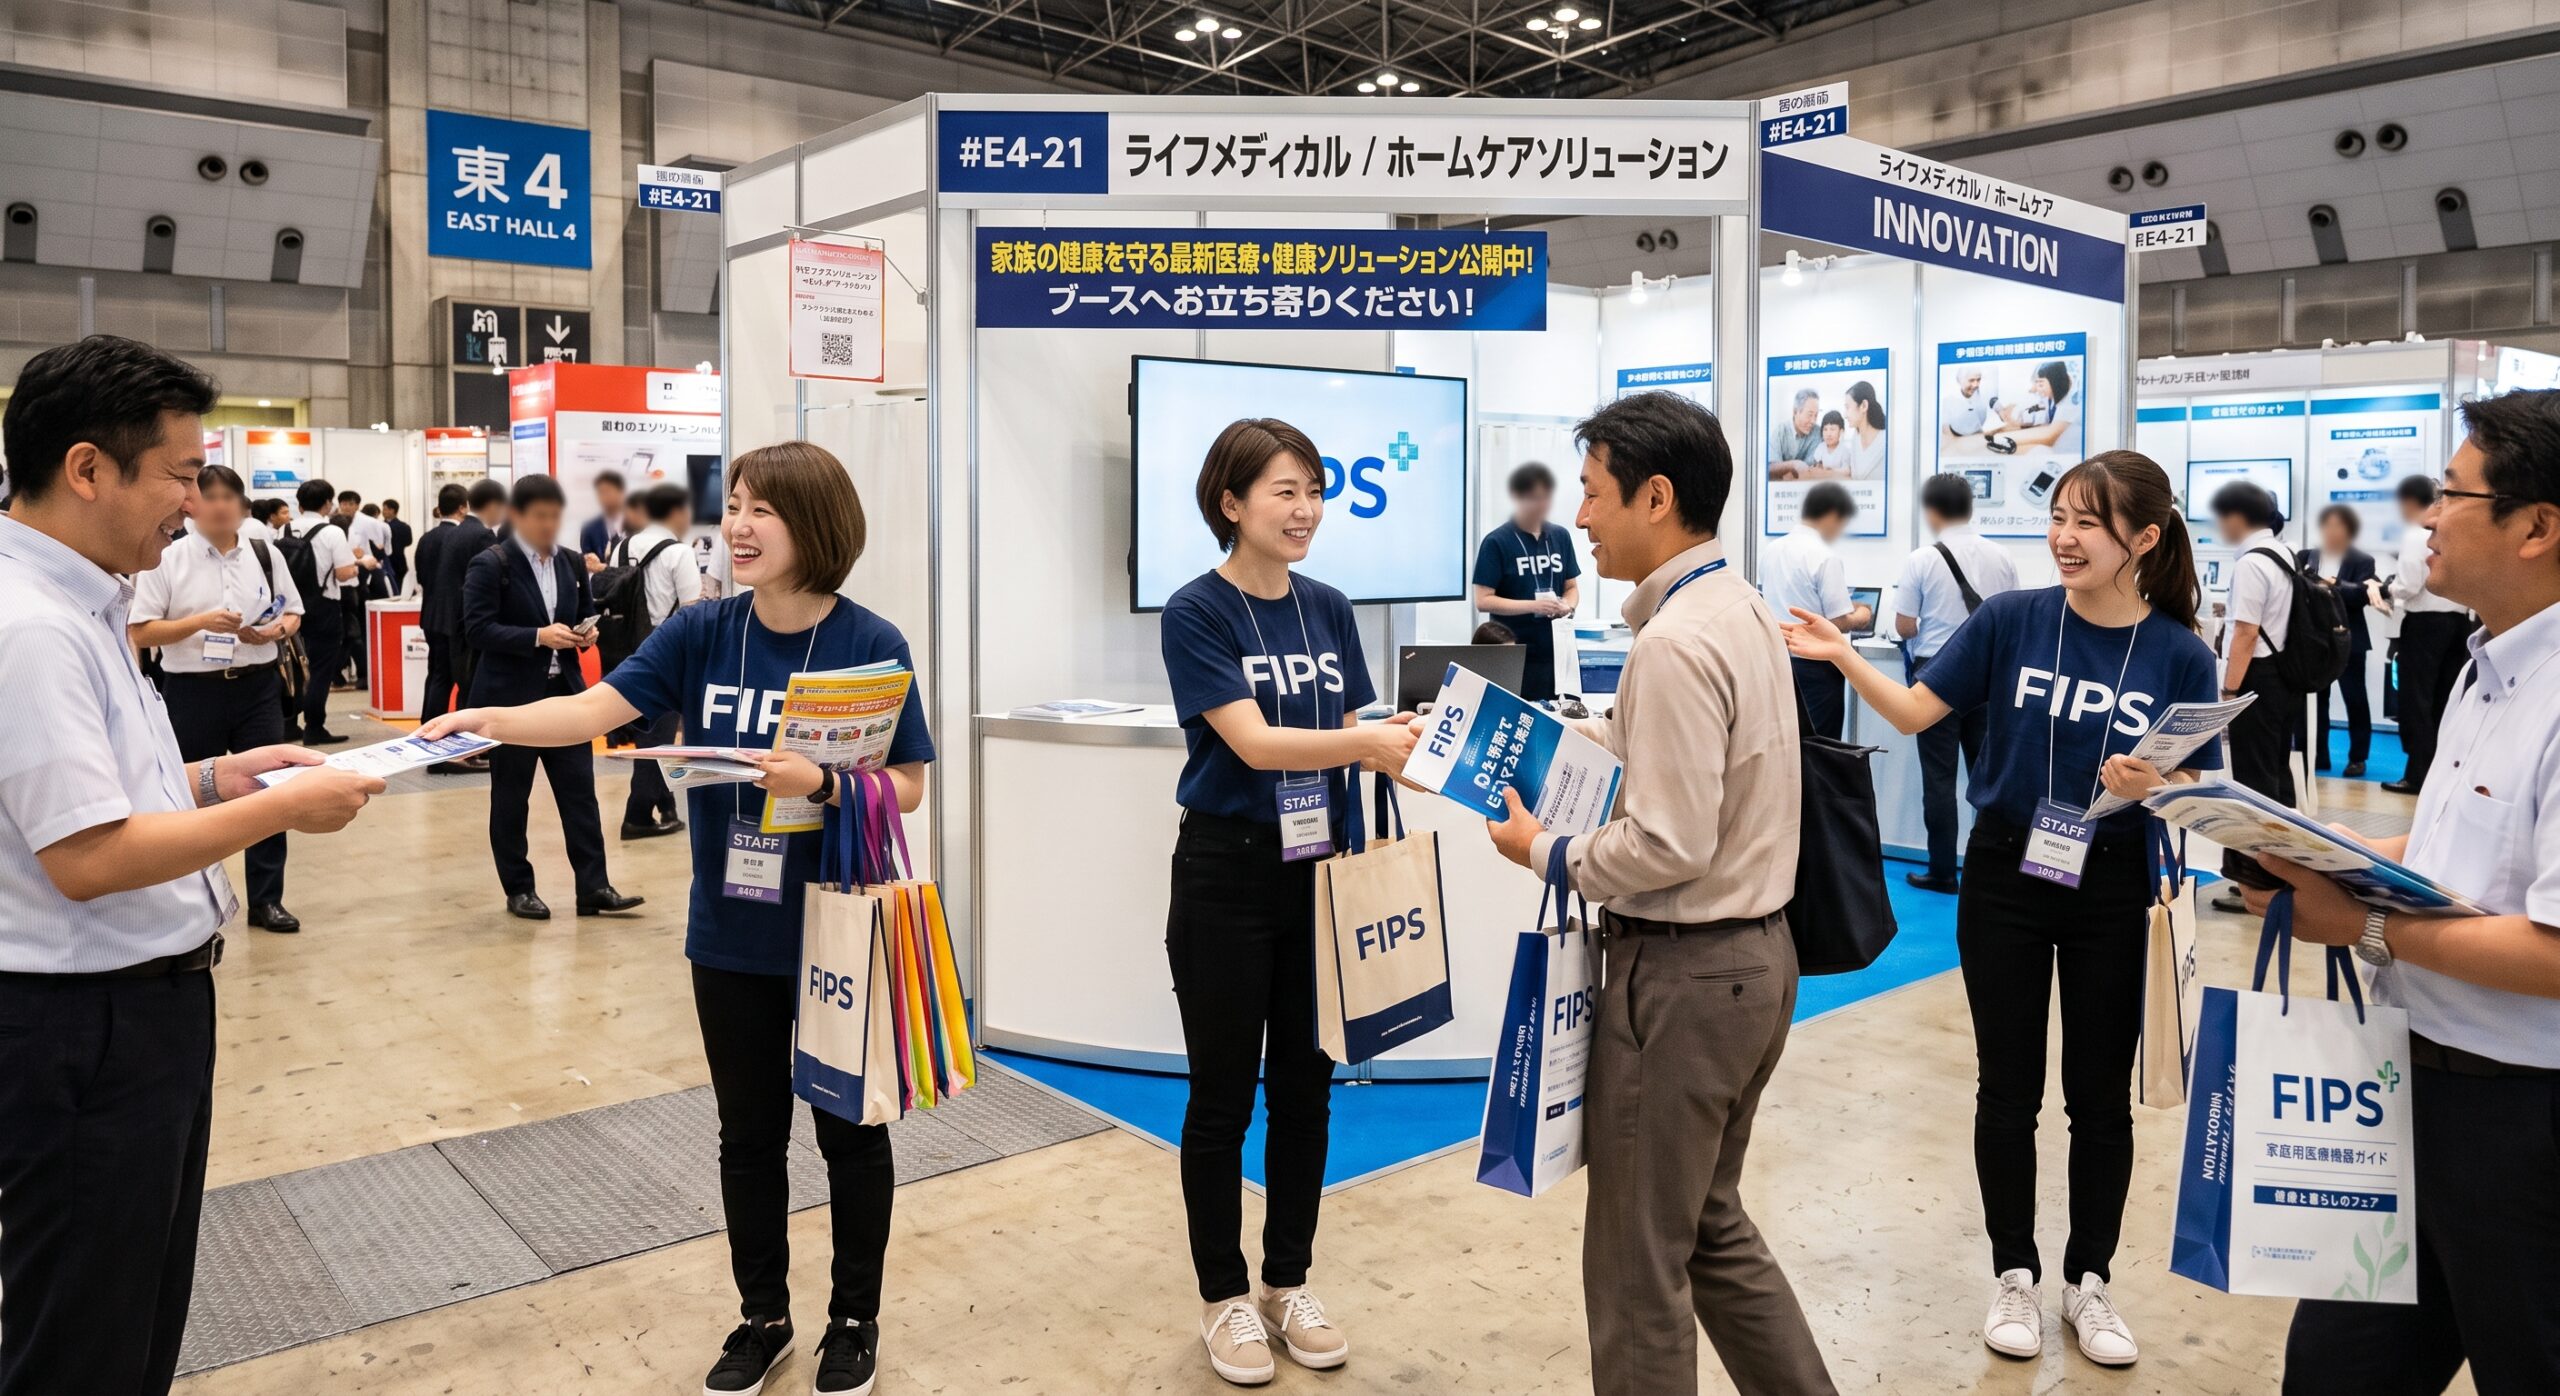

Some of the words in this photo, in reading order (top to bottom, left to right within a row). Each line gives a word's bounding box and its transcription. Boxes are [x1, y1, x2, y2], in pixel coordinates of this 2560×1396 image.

[1768, 112, 1835, 143] #E4-21
[959, 136, 1082, 168] #E4-21
[1125, 132, 1352, 179] ライフメディカル
[1387, 134, 1729, 180] ホームケアソリューション
[452, 145, 510, 203] 東
[524, 153, 568, 209] 4
[648, 187, 711, 209] #E4-21
[1879, 153, 1981, 201] ライフメディカル
[1994, 185, 2054, 218] ホームケア
[447, 210, 500, 233] EAST
[506, 217, 559, 239] HALL
[563, 223, 577, 241] 4
[1873, 195, 2058, 277] INNOVATION
[1048, 283, 1474, 317] ブースへお立ち寄りください!
[1320, 456, 1387, 519] PS
[1516, 552, 1563, 576] FIPS
[1242, 652, 1344, 697] FIPS
[702, 683, 787, 735] FIP
[2014, 666, 2155, 737] FIPS
[1283, 793, 1322, 811] STAFF
[733, 833, 780, 850] STAFF
[2040, 816, 2087, 838] STAFF
[1355, 907, 1426, 961] FIPS
[809, 964, 854, 1011] FIPS
[1553, 985, 1593, 1036] FIPS
[2272, 1073, 2384, 1128] FIPS
[2266, 1142, 2388, 1166] 家庭用医療機器ガイド
